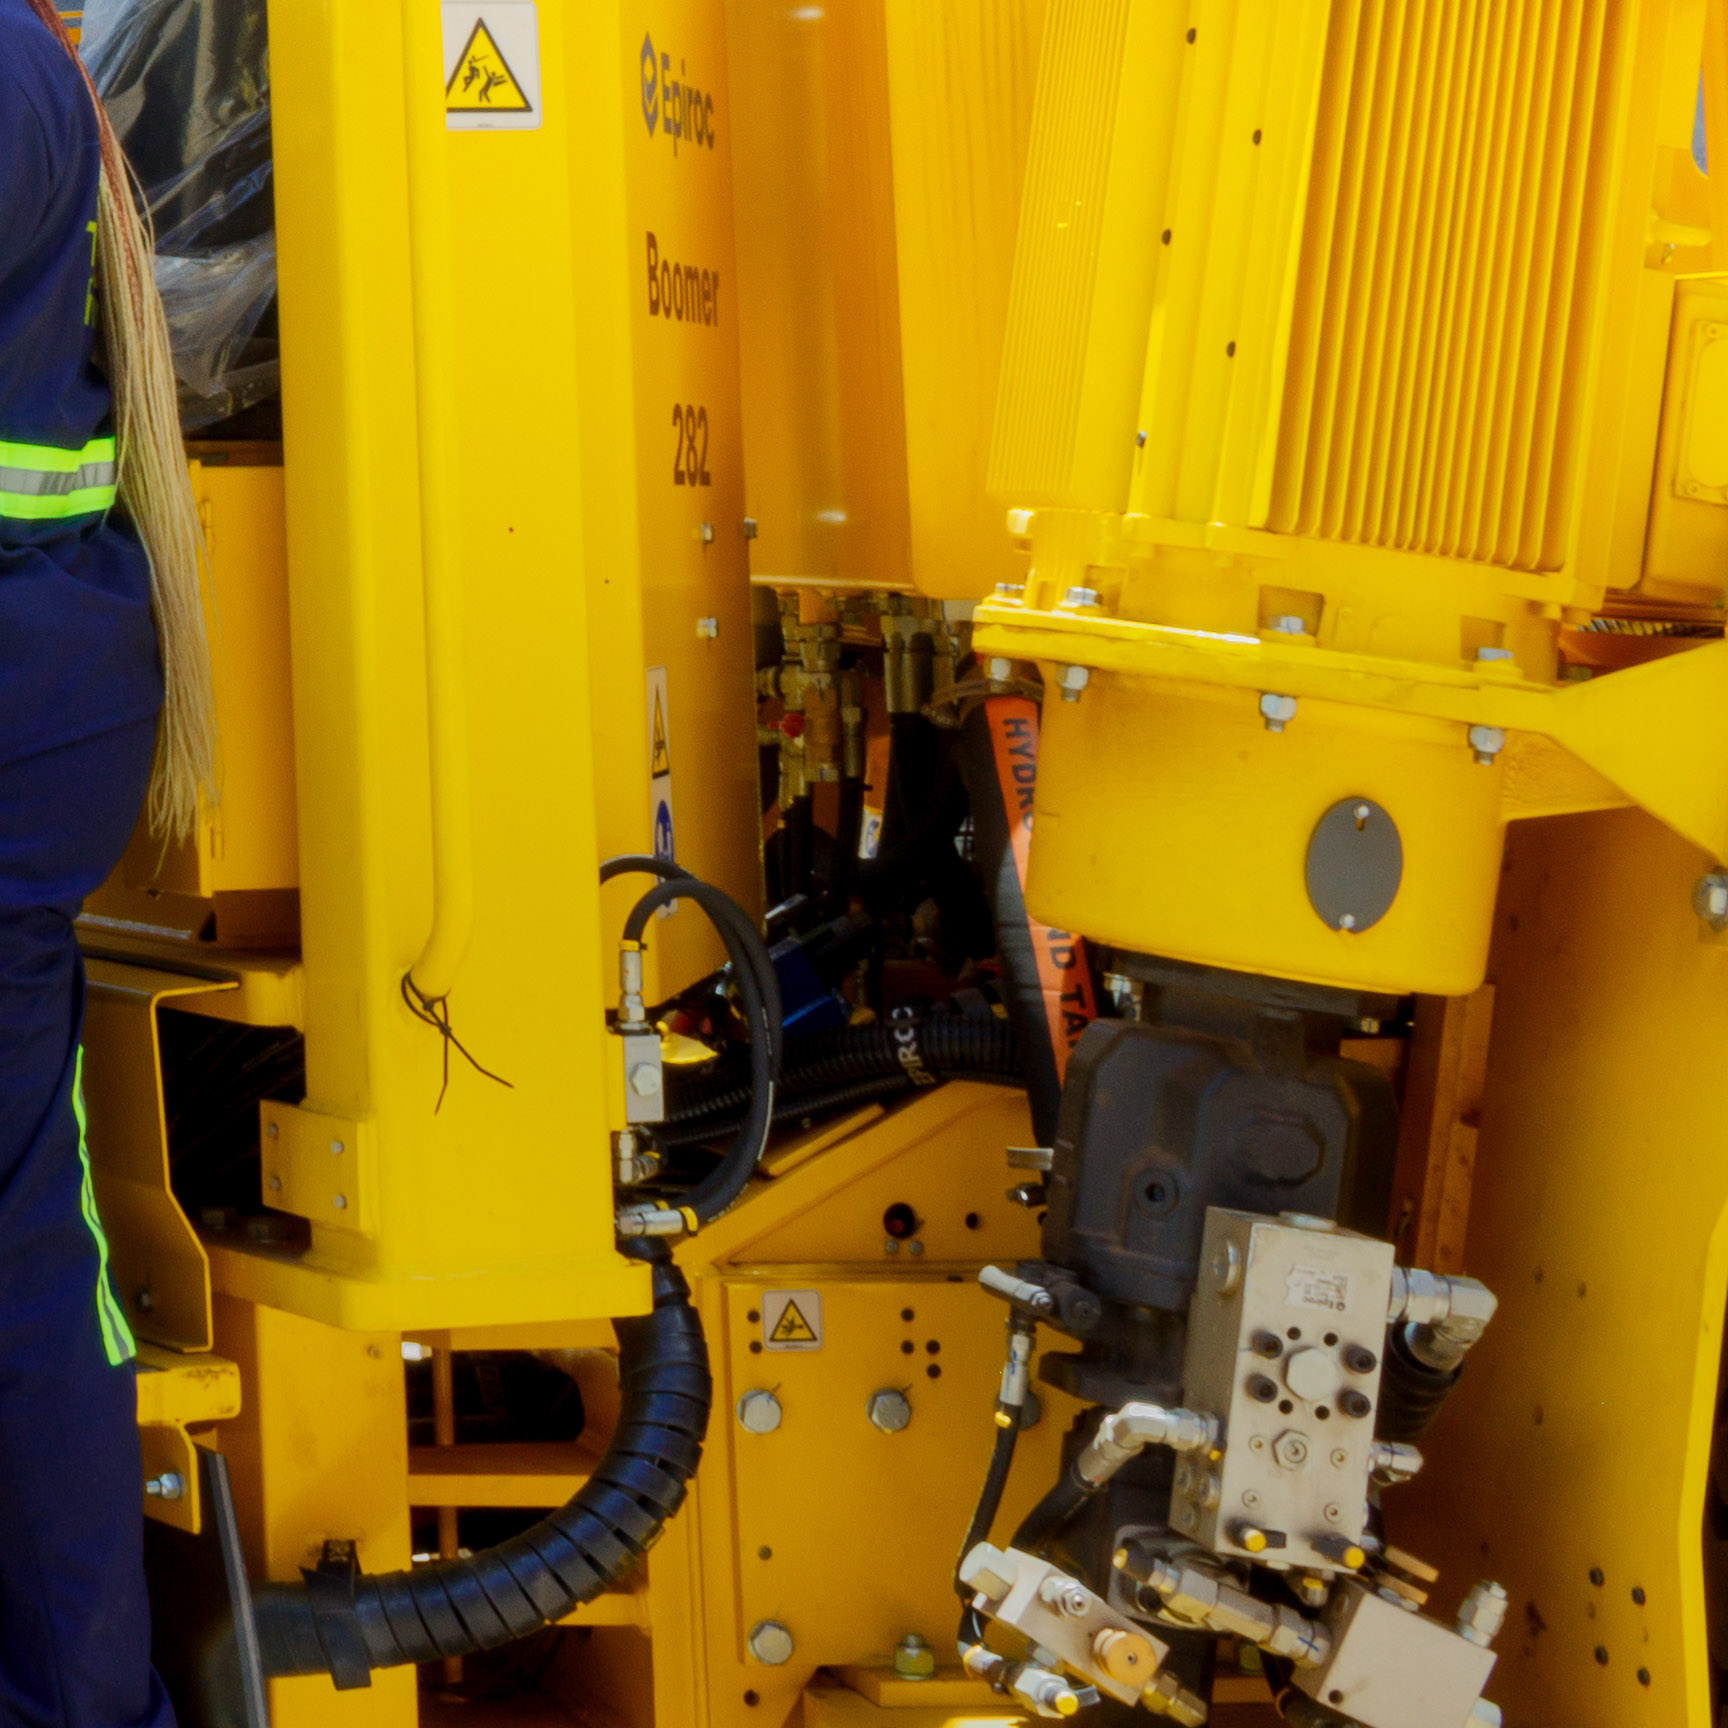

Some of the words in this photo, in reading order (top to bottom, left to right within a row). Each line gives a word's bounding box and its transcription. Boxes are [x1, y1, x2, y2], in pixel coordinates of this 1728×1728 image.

[660, 51, 715, 160] Epiroc
[646, 230, 720, 327] Boomer
[671, 402, 712, 488] 282
